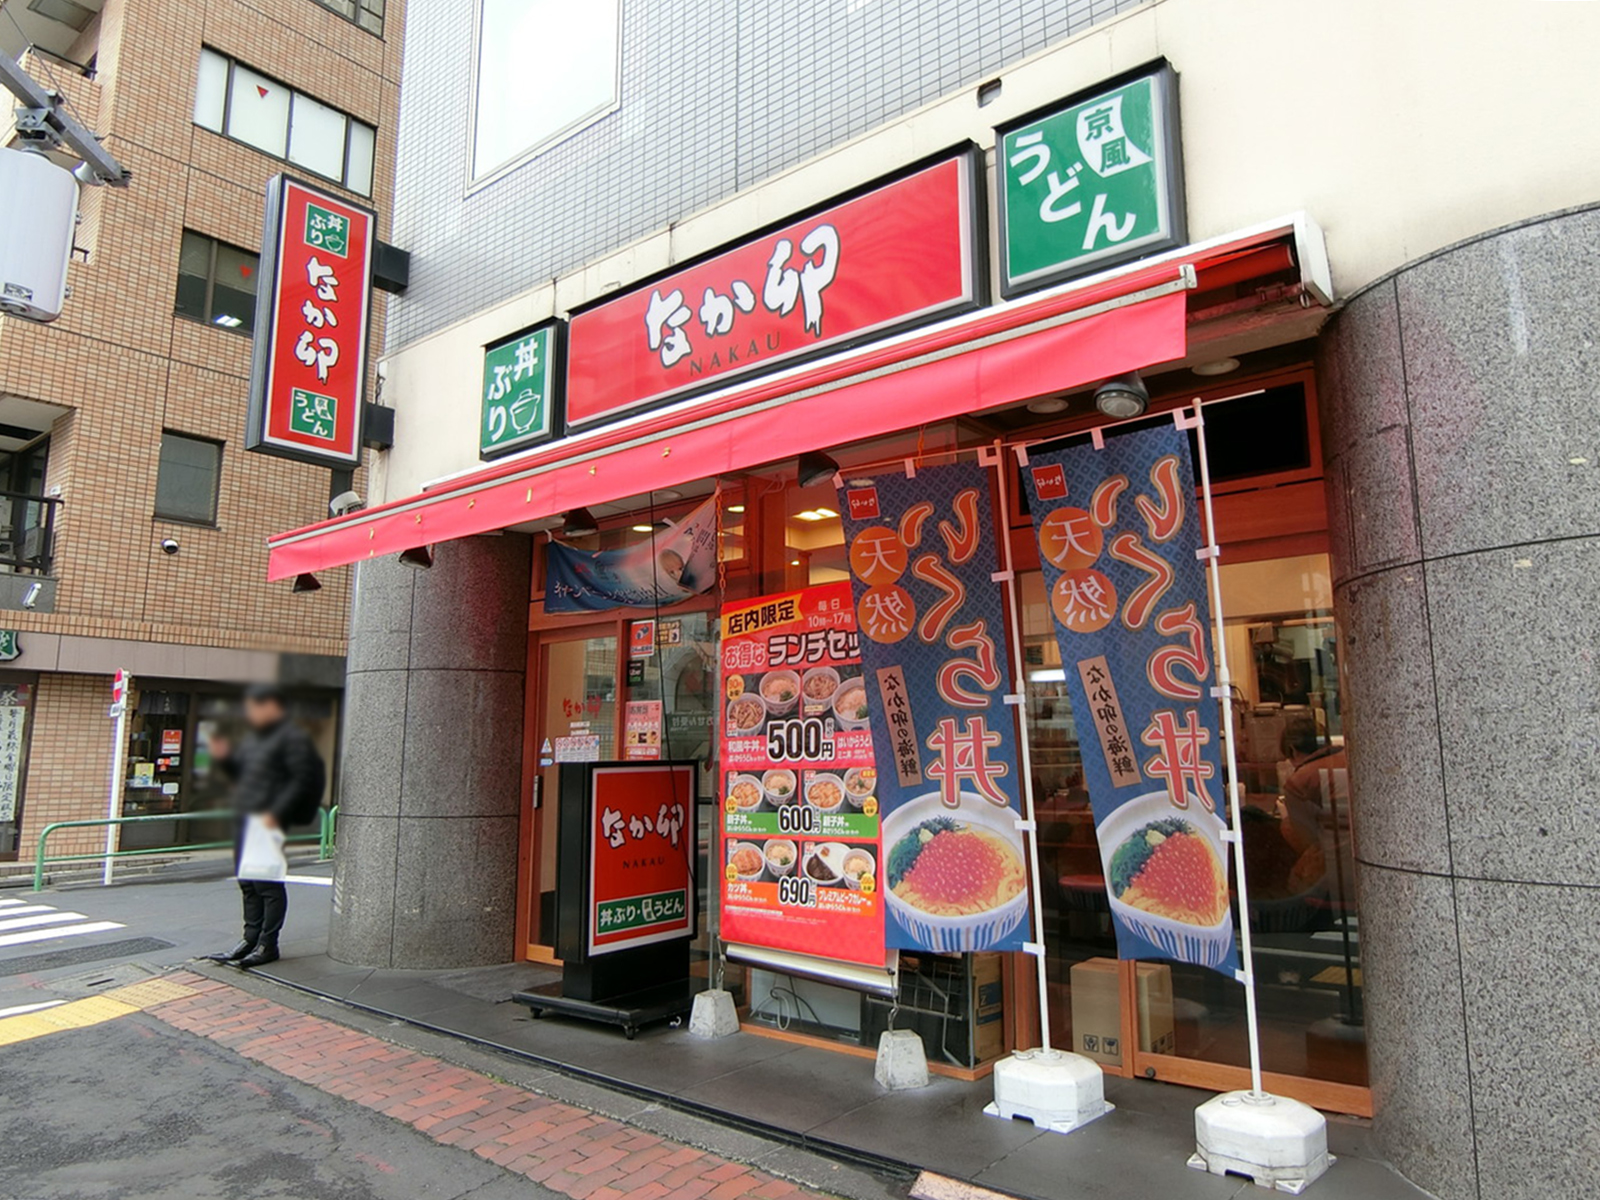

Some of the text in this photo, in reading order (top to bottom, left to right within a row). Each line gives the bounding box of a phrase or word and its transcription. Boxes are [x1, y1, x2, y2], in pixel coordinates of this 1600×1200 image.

[1083, 106, 1131, 173] 京風
[1009, 130, 1137, 250] うどん
[644, 223, 840, 368] なか卯
[294, 255, 339, 385] なか卯
[689, 331, 781, 376] NAKAU
[295, 392, 328, 436] うどん
[728, 599, 795, 635] 店内限定
[725, 641, 766, 669] お得な
[602, 803, 684, 849] なか卯
[622, 857, 665, 869] NAKAU
